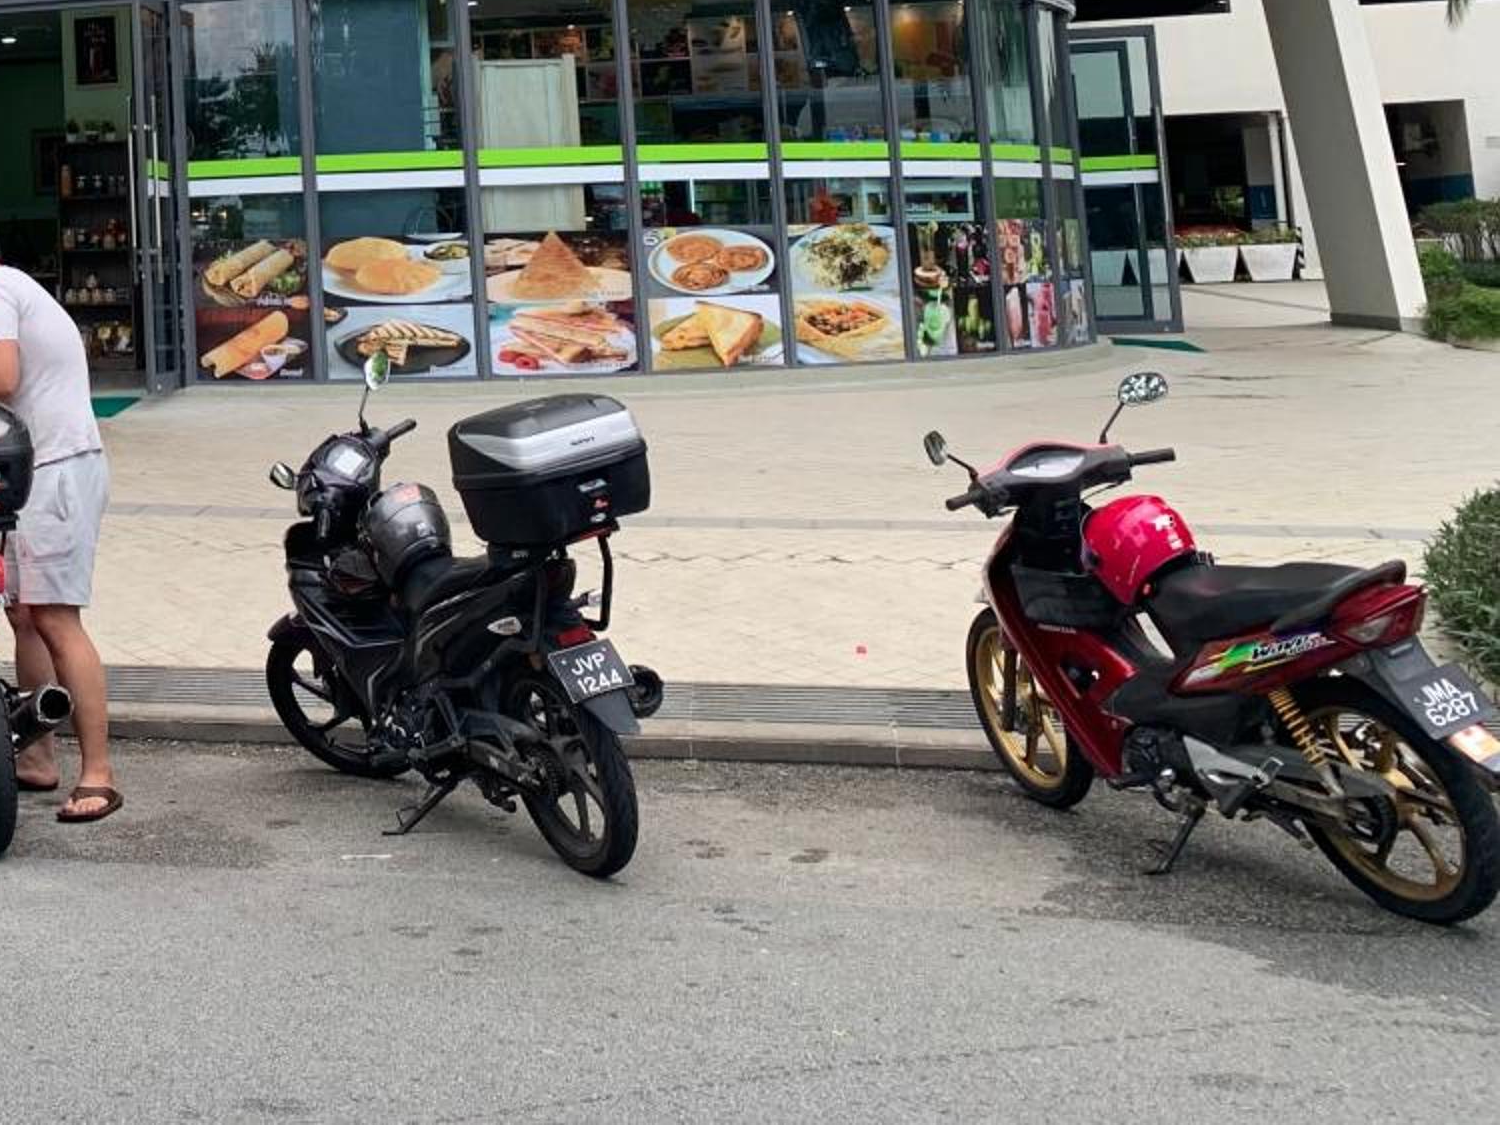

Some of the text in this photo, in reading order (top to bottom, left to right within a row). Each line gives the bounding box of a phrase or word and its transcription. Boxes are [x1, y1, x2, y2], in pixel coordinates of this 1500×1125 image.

[571, 652, 605, 675] JVP
[577, 668, 623, 694] 1244
[1421, 678, 1461, 707] JMA
[1425, 691, 1479, 726] 6287
